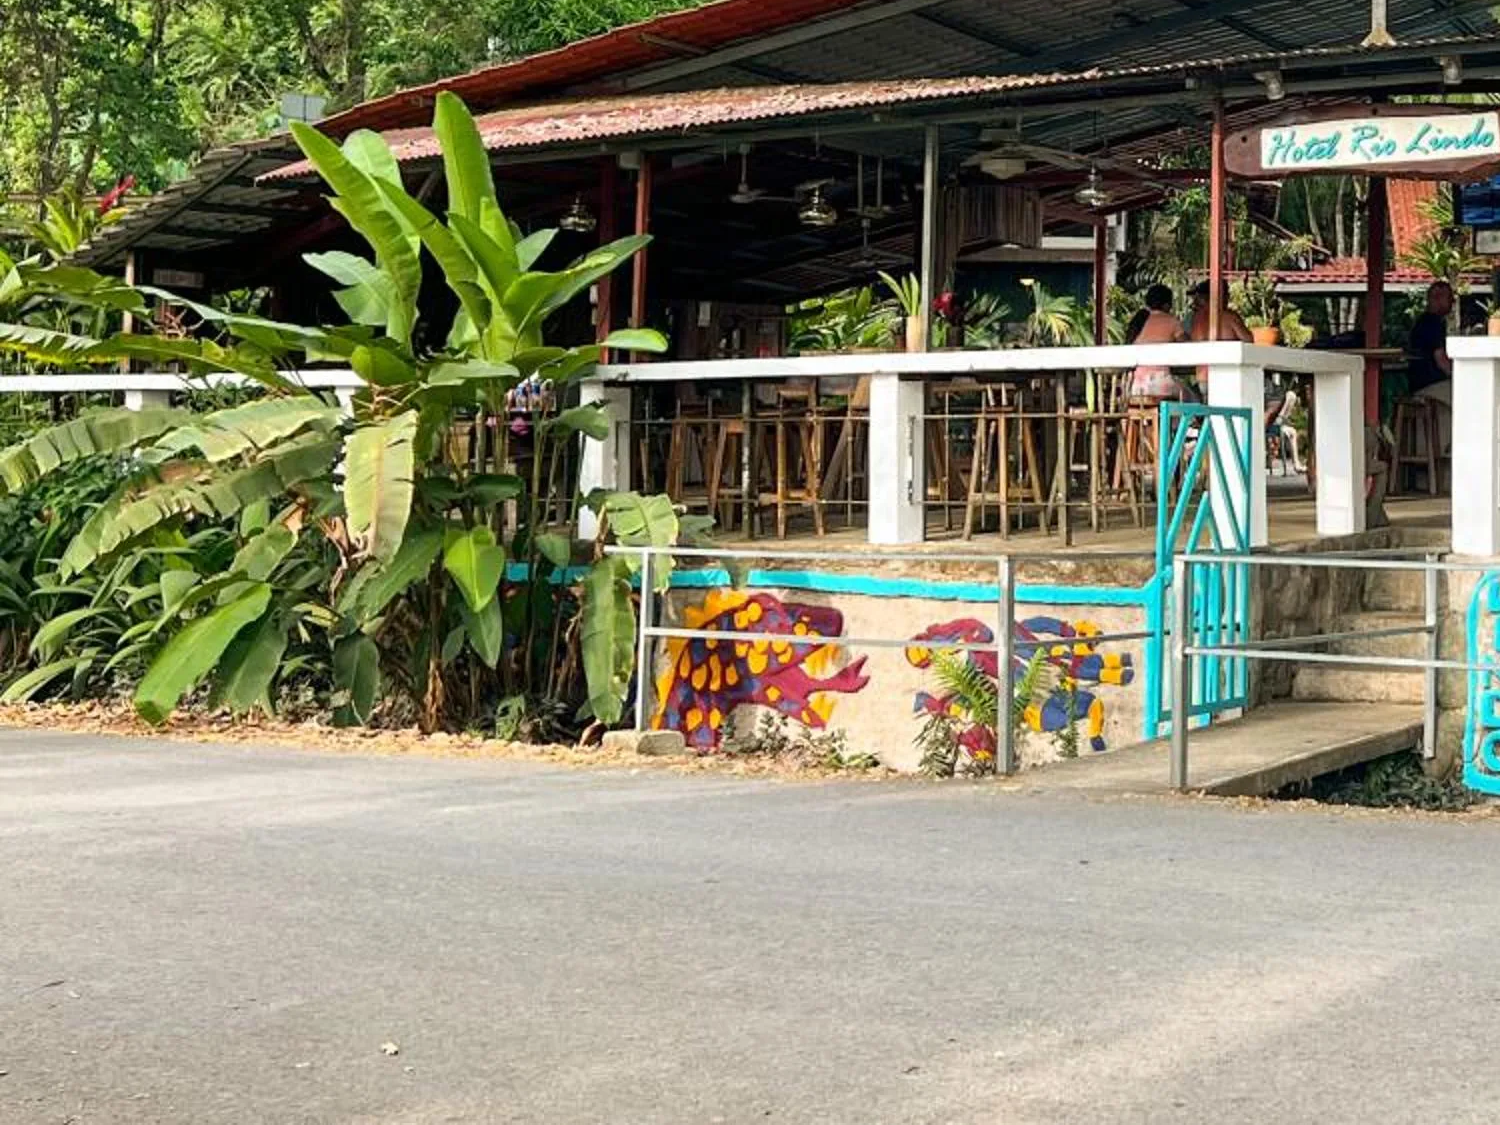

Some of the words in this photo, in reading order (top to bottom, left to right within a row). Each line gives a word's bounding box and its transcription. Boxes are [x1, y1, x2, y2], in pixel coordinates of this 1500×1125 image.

[1266, 130, 1341, 165] Hotel
[1350, 123, 1397, 161] Rio
[1405, 118, 1495, 154] Lindo
